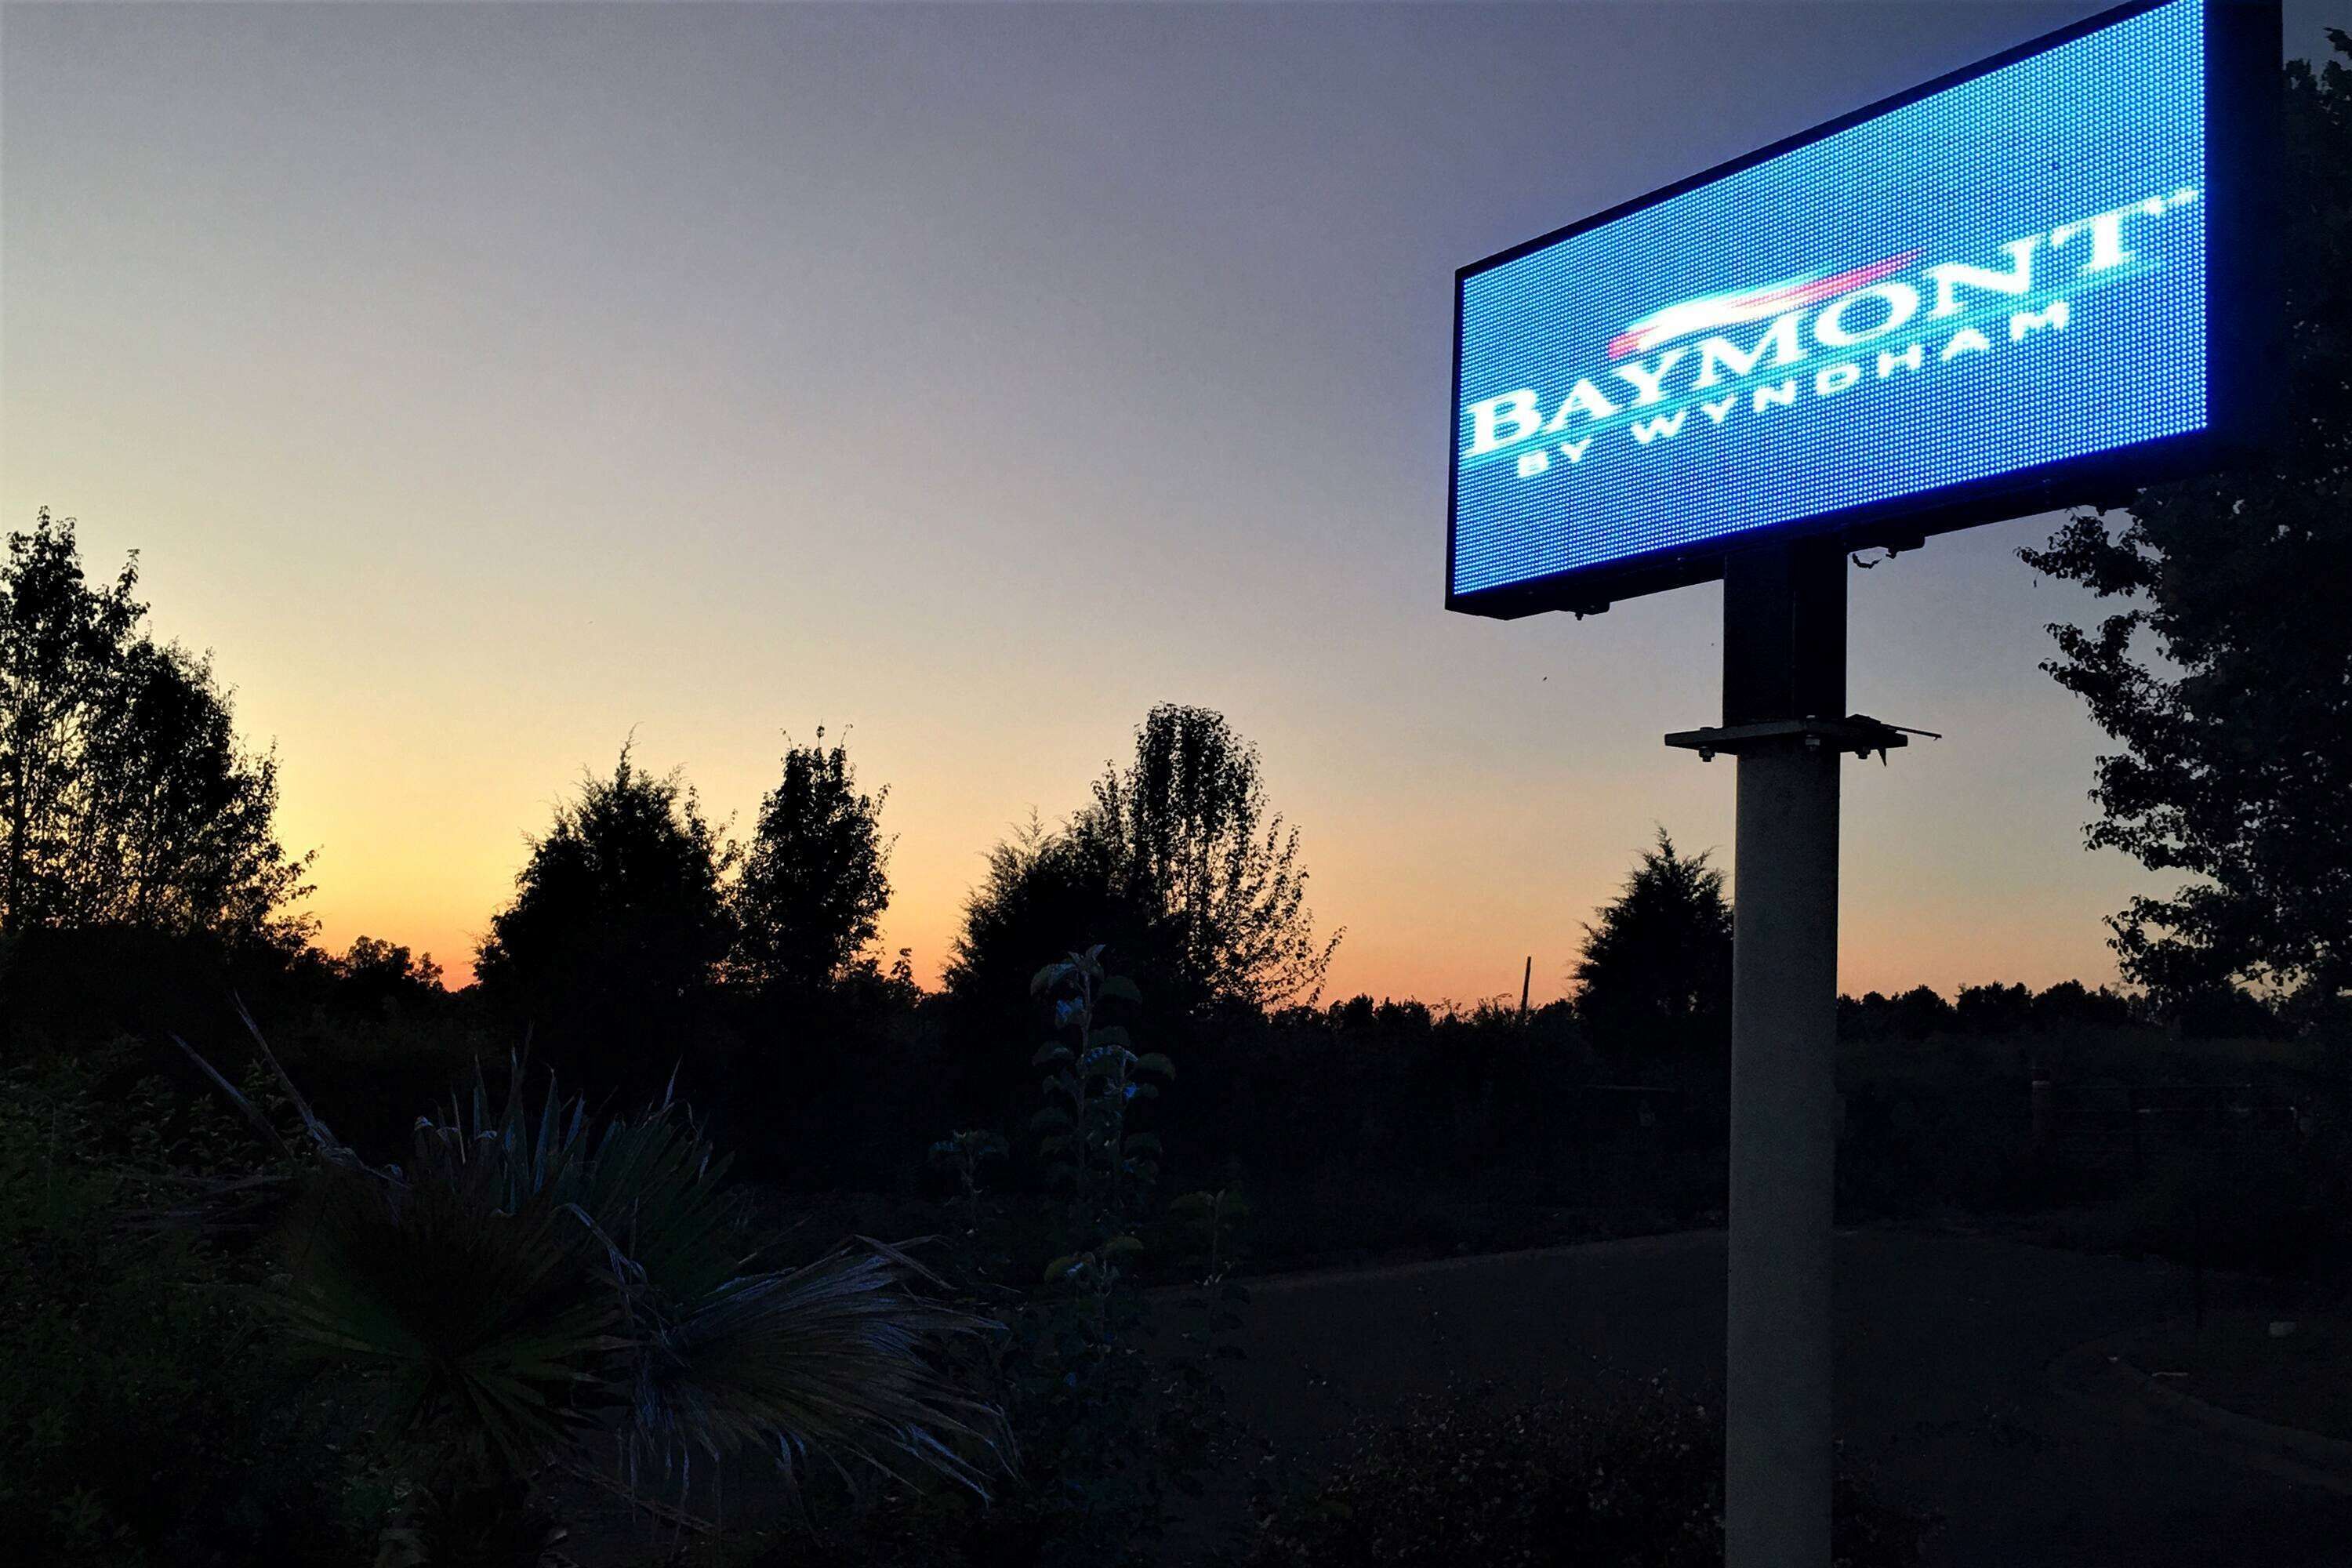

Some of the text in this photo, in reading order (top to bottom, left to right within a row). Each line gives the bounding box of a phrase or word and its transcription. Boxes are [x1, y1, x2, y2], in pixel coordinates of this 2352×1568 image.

[1463, 195, 2166, 458] BAYMONT
[1516, 300, 2070, 478] BY WYNDHAM
